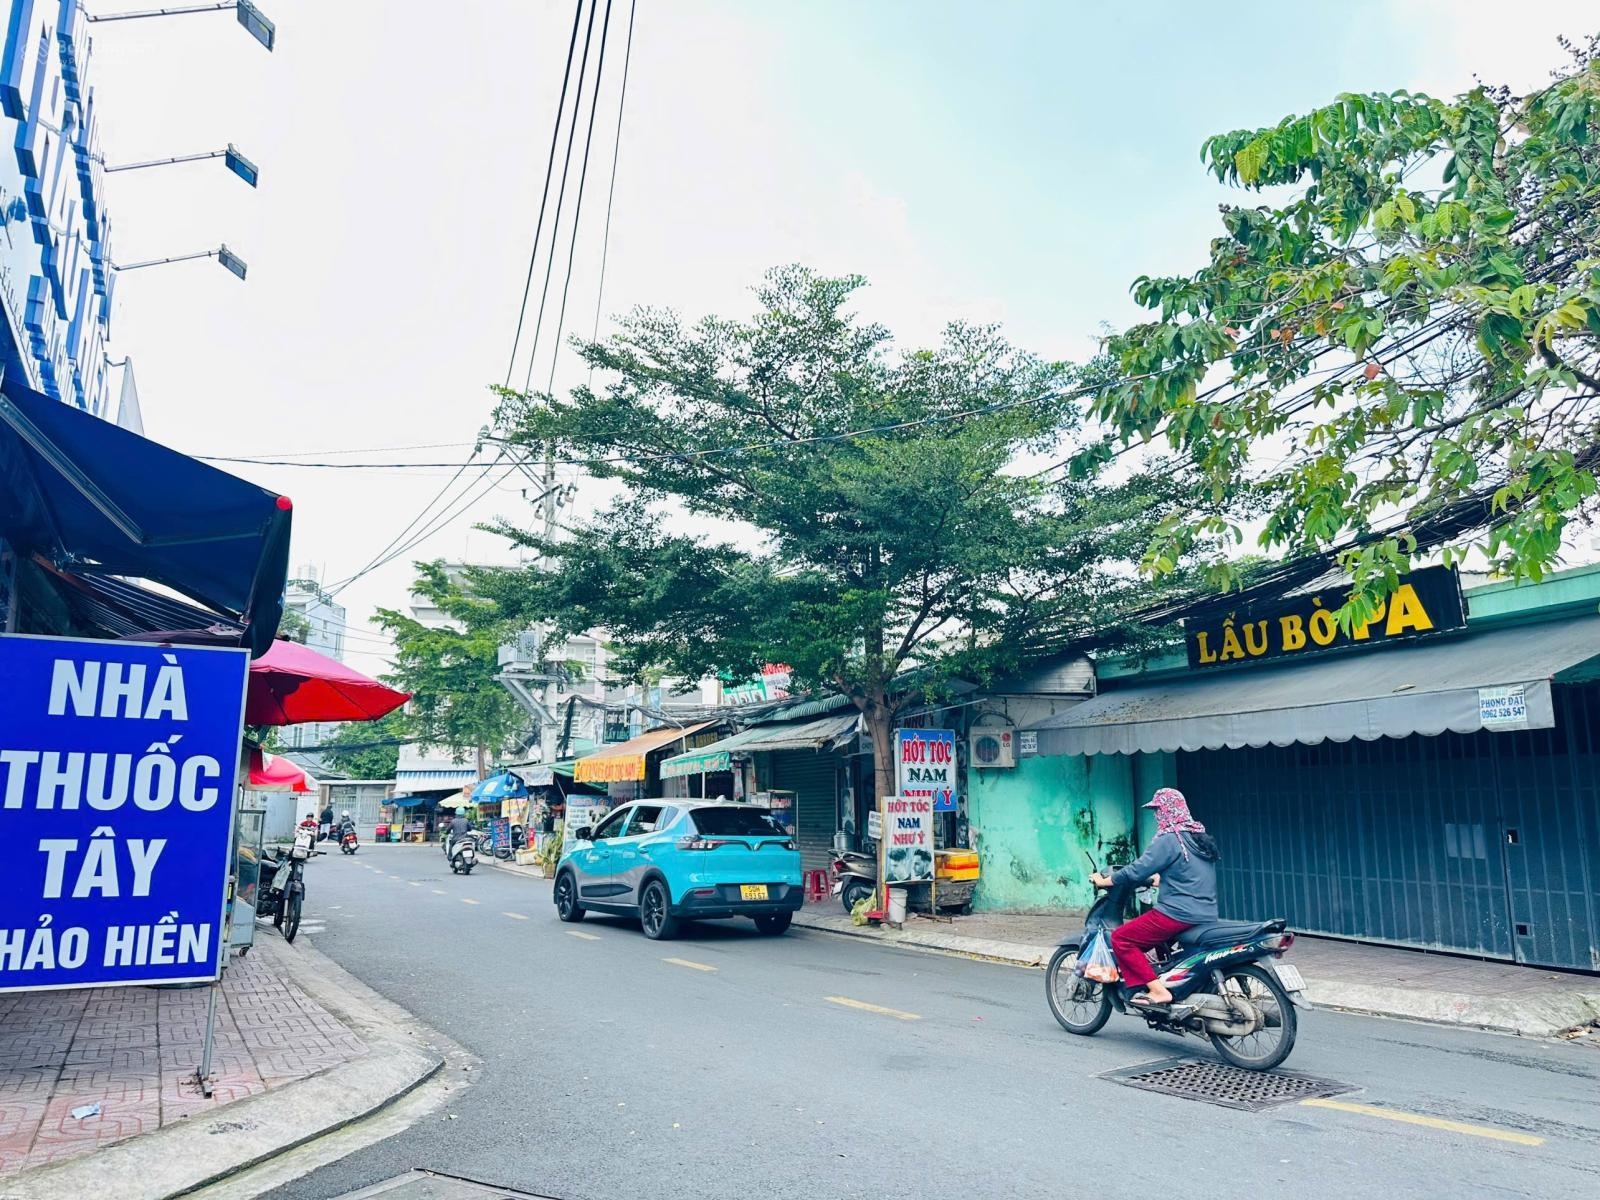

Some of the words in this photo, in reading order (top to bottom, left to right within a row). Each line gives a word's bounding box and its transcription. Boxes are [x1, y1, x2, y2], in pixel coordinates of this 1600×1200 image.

[1279, 597, 1337, 651] BÒ
[1349, 584, 1435, 641] PA
[48, 653, 188, 721] NHÀ
[0, 735, 220, 812] THUỐC
[901, 732, 927, 764] HỚT
[907, 767, 947, 783] NAM
[893, 831, 916, 845] NHƯ
[897, 817, 921, 829] NAM
[38, 826, 167, 899] TÂY
[103, 911, 211, 968] HIỀN
